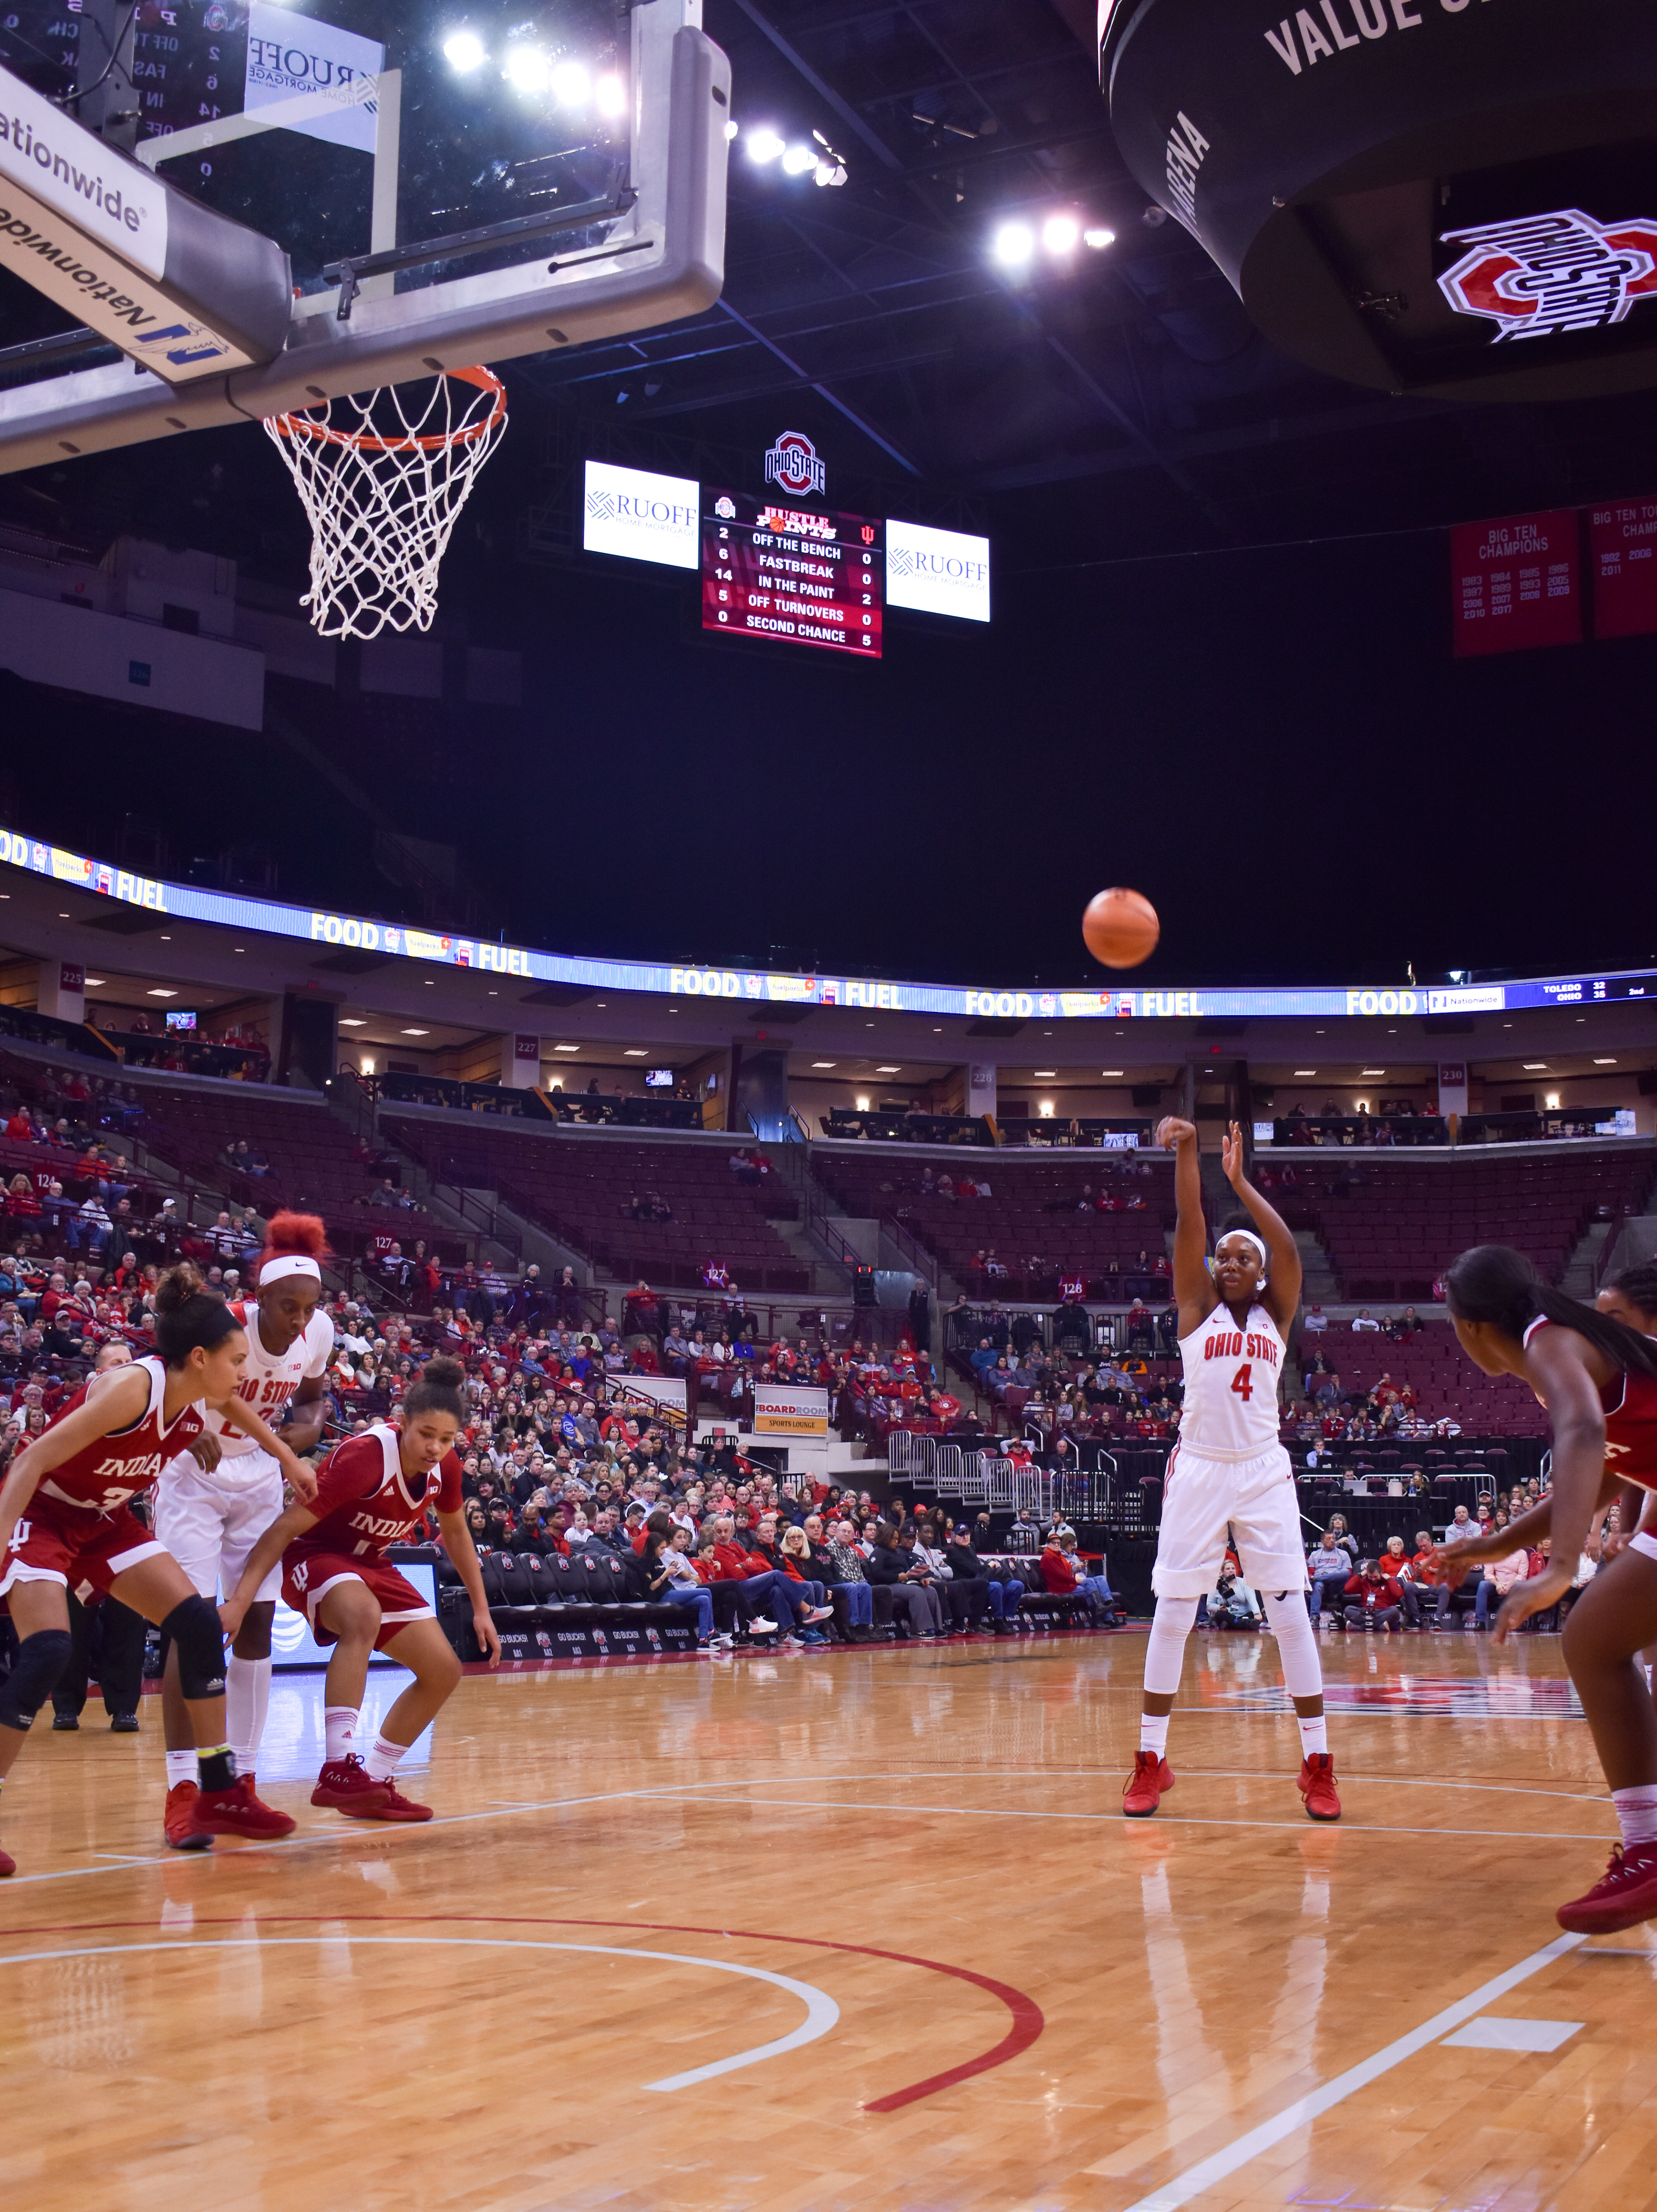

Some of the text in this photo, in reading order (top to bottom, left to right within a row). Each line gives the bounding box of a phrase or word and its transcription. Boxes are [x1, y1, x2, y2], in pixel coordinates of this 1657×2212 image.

[1264, 0, 1423, 75] VALUE
[617, 494, 696, 526] RUOFF
[764, 506, 829, 528] HUSTLE
[1593, 511, 1611, 525] BIG
[1616, 508, 1636, 521] TEN
[616, 516, 695, 537] HOME MORTGAGE
[1489, 524, 1537, 544] BIG TEN
[719, 527, 871, 564] 2 OFF THE BENCH 0
[1479, 537, 1548, 559] CHAMPIONS
[719, 549, 871, 585] 6 FASTBREAK 0
[915, 551, 987, 581] RUOFF
[1601, 565, 1621, 576] 2011
[715, 569, 871, 604] 14 IN THE PAINT 2
[915, 573, 986, 591] HOME MORTGAGE
[719, 590, 871, 625] 5 OFF TURNOVERS 0
[1464, 604, 1512, 619] 2010 2017
[718, 611, 871, 646] 0 SECOND CHANCE 5
[118, 870, 167, 912] FUEL
[311, 912, 379, 950] FOOD
[479, 943, 532, 977] FUEL
[63, 971, 81, 984] 225
[671, 968, 740, 997] FOOD
[847, 982, 904, 1009] FUEL
[1543, 984, 1581, 994] TOLEDO
[1556, 990, 1606, 1001] OHIO 35
[1629, 988, 1644, 996] 2nd
[966, 991, 1033, 1017] FOOD
[1143, 993, 1204, 1016] FUEL
[1347, 991, 1418, 1015] FOOD
[1450, 996, 1498, 1005] Nationwide
[518, 1042, 536, 1052] 227
[973, 1073, 992, 1082] 228
[1443, 1071, 1462, 1079] 230
[37, 1174, 55, 1188] 124
[375, 1237, 392, 1249] 127
[707, 1269, 725, 1280] 127
[1062, 1284, 1082, 1293] 128
[1204, 1332, 1277, 1368] OHIO STATE
[238, 1379, 259, 1402] IO
[1231, 1364, 1253, 1401] 4
[759, 1404, 827, 1415] BOARDROOM
[93, 1453, 172, 1476] INDIA
[498, 1634, 528, 1643] GO BUCKS!
